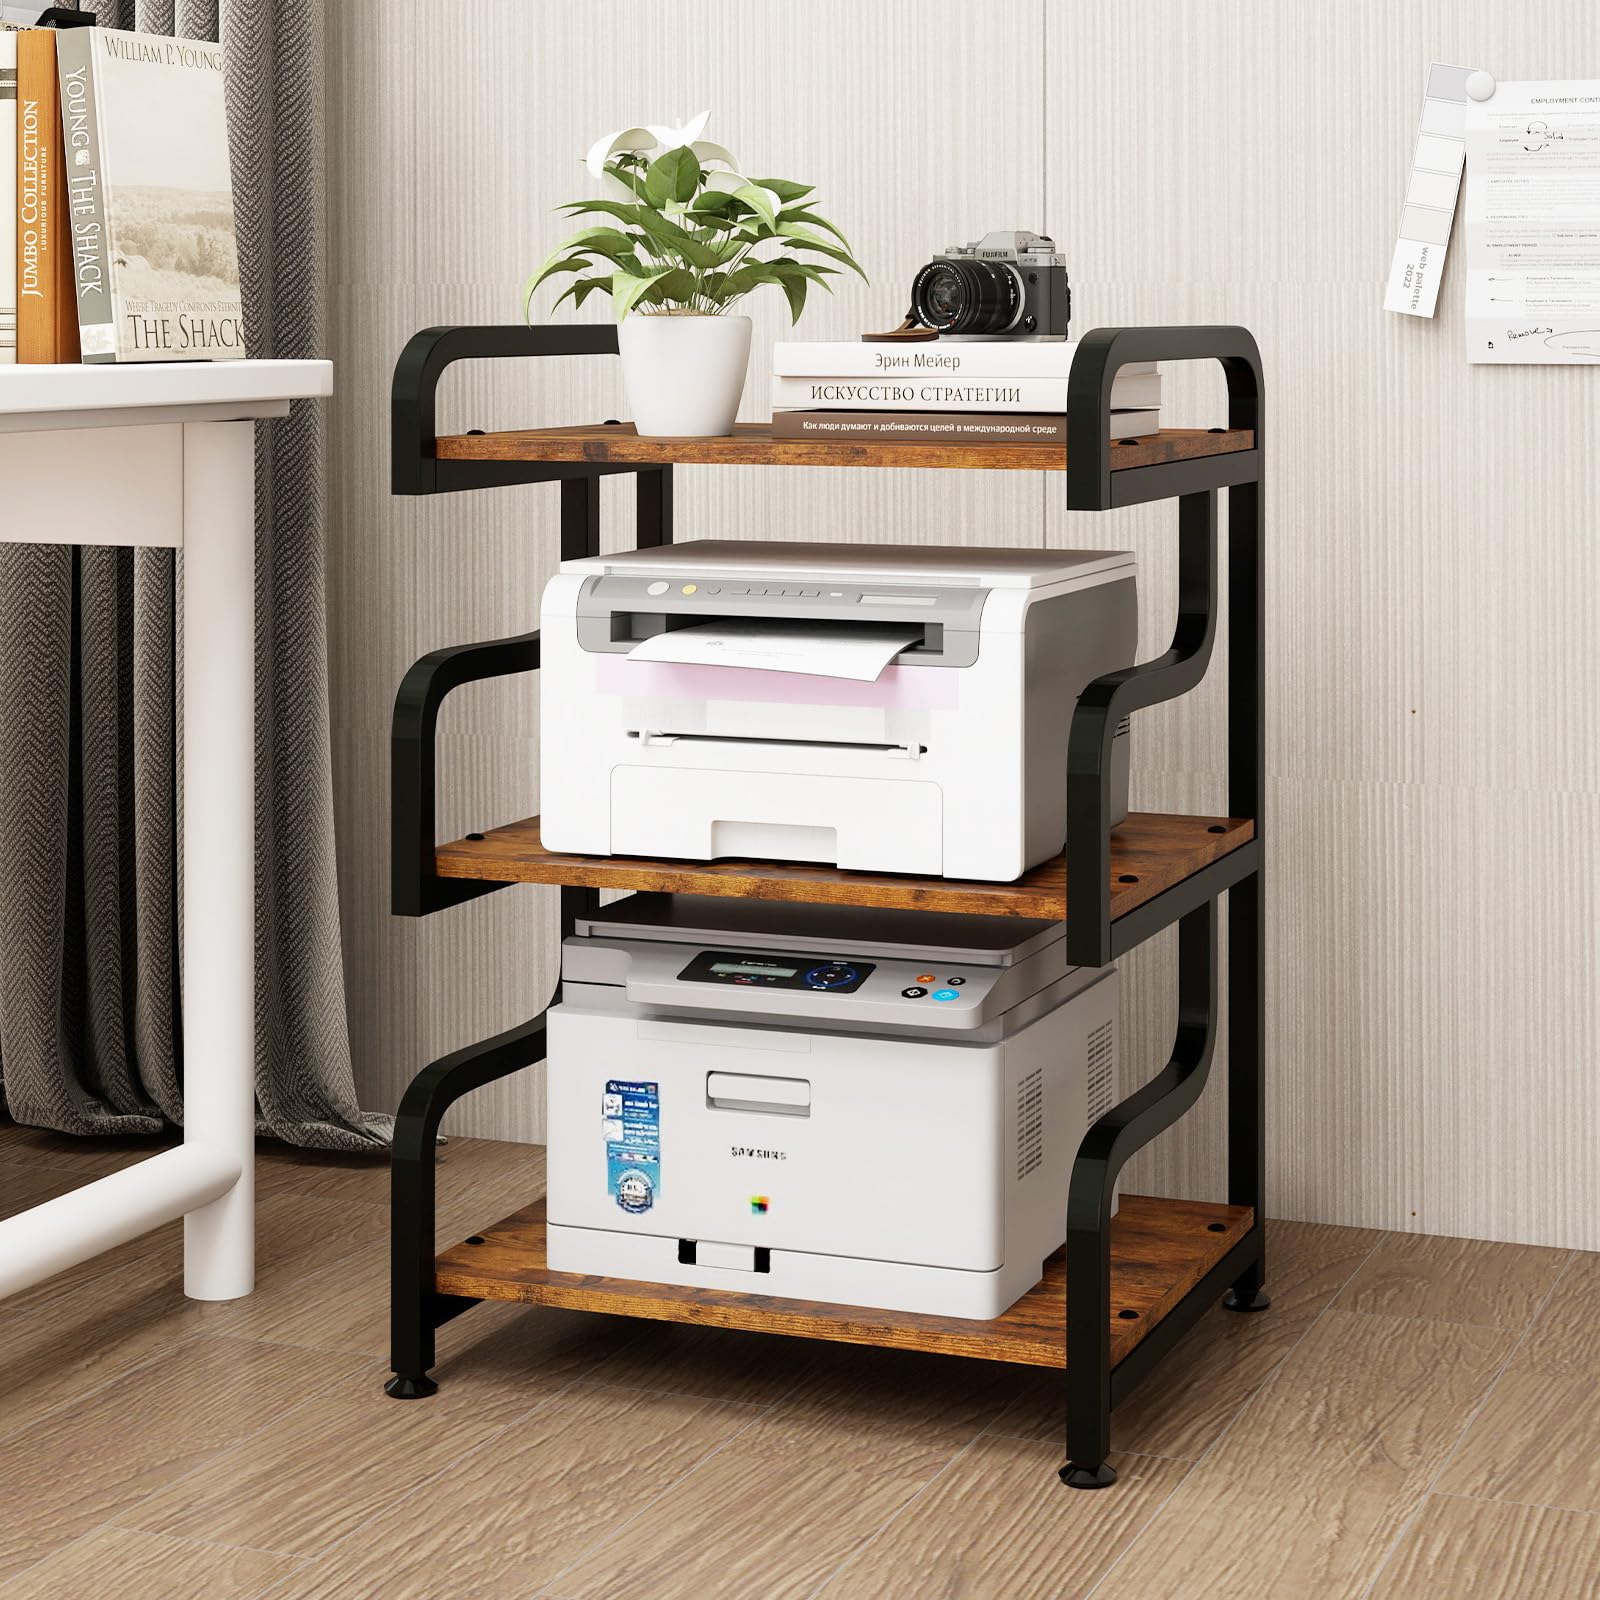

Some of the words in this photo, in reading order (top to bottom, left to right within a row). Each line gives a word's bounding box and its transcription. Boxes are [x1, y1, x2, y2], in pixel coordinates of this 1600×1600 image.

[104, 35, 162, 64] WILLIAM
[166, 43, 175, 65] P.
[176, 44, 222, 71] YOUNG
[65, 65, 89, 147] YOUNG
[22, 100, 38, 224] COLLECTION
[71, 170, 96, 217] THE
[22, 229, 43, 297] JUMBO
[75, 222, 103, 298] SHACK
[982, 251, 1009, 259] FUJIFILM
[1419, 246, 1429, 270] web
[1402, 263, 1415, 289] 2022
[1410, 271, 1424, 310] palette
[127, 314, 172, 349] THE
[178, 313, 246, 349] SHACK
[875, 352, 910, 371] Эрин
[914, 352, 961, 371] Мейер
[811, 385, 915, 401] ИСКУССТВО
[920, 386, 1021, 402] СТРАТЕГИИ
[803, 421, 818, 430] Как
[818, 422, 840, 432] люди
[840, 422, 873, 432] думают
[873, 423, 880, 431] и
[880, 422, 930, 432] добиваются
[930, 423, 955, 433] целей
[963, 424, 1031, 434] международной
[1032, 425, 1058, 435] среде
